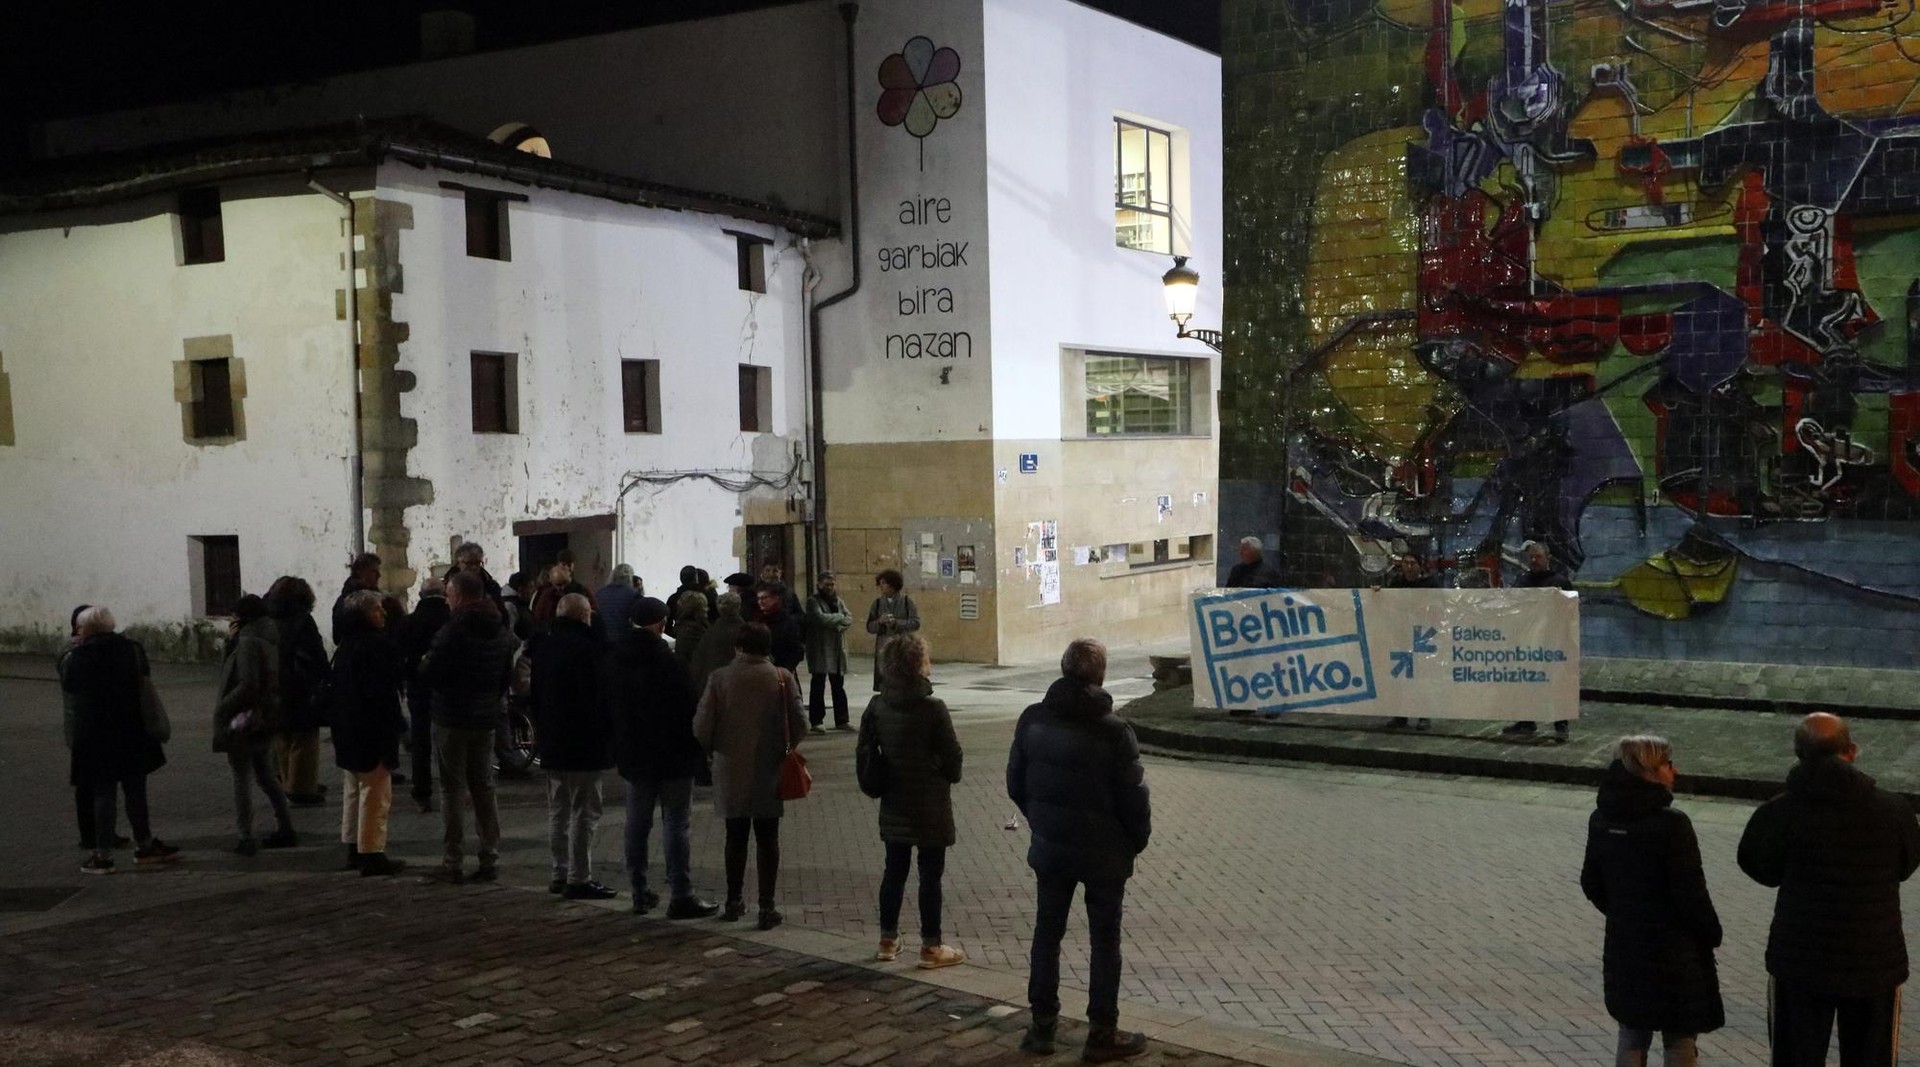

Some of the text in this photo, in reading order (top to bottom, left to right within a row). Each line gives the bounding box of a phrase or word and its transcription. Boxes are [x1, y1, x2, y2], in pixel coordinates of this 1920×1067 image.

[899, 194, 951, 225] aire
[878, 239, 969, 272] garbiak
[898, 286, 953, 316] bira
[886, 331, 972, 359] nazan
[1209, 596, 1327, 648] Behin
[1452, 625, 1506, 641] Bakea.
[1452, 645, 1568, 666] Konponbidea.
[1219, 653, 1363, 705] betiko.
[1452, 666, 1550, 683] Elkarbizitza.
